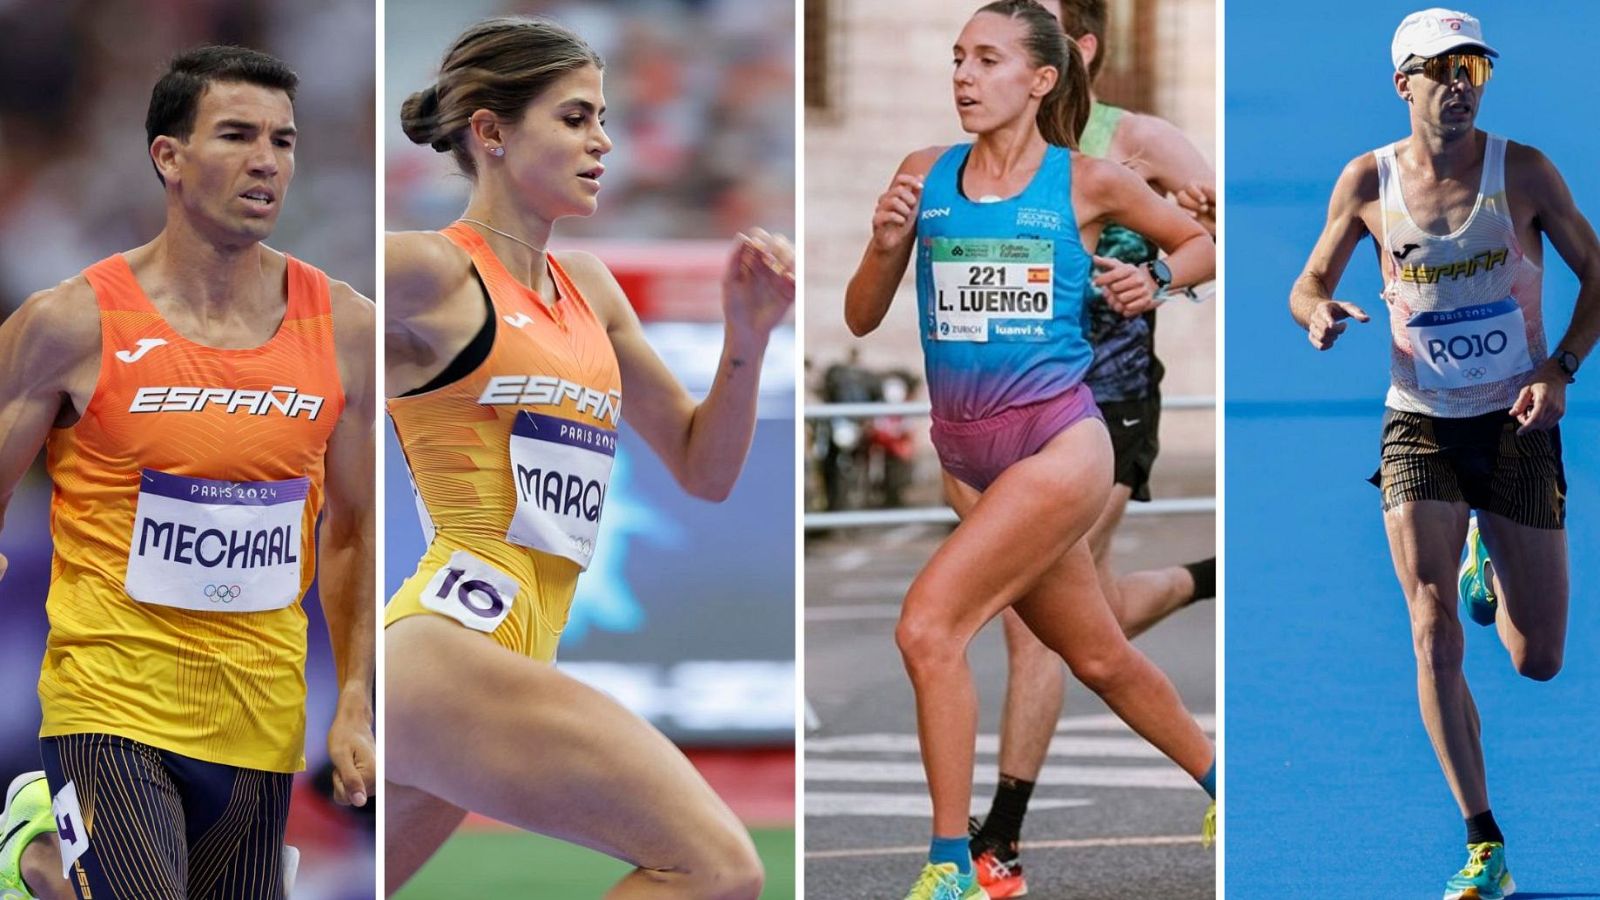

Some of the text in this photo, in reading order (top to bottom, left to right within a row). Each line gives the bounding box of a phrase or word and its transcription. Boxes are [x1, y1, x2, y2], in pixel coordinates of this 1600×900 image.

[969, 266, 1006, 286] 221
[938, 290, 1048, 313] L. LUENGO
[1433, 307, 1493, 322] PARIS 2024
[952, 323, 982, 334] ZURICH
[995, 324, 1031, 334] luanvi
[1428, 329, 1508, 364] ROJO
[128, 385, 325, 421] ESPAÑA
[560, 423, 616, 451] PARIS 202
[190, 483, 277, 500] PARIS 2024
[138, 517, 297, 569] MECHAAL
[435, 567, 504, 619] 10
